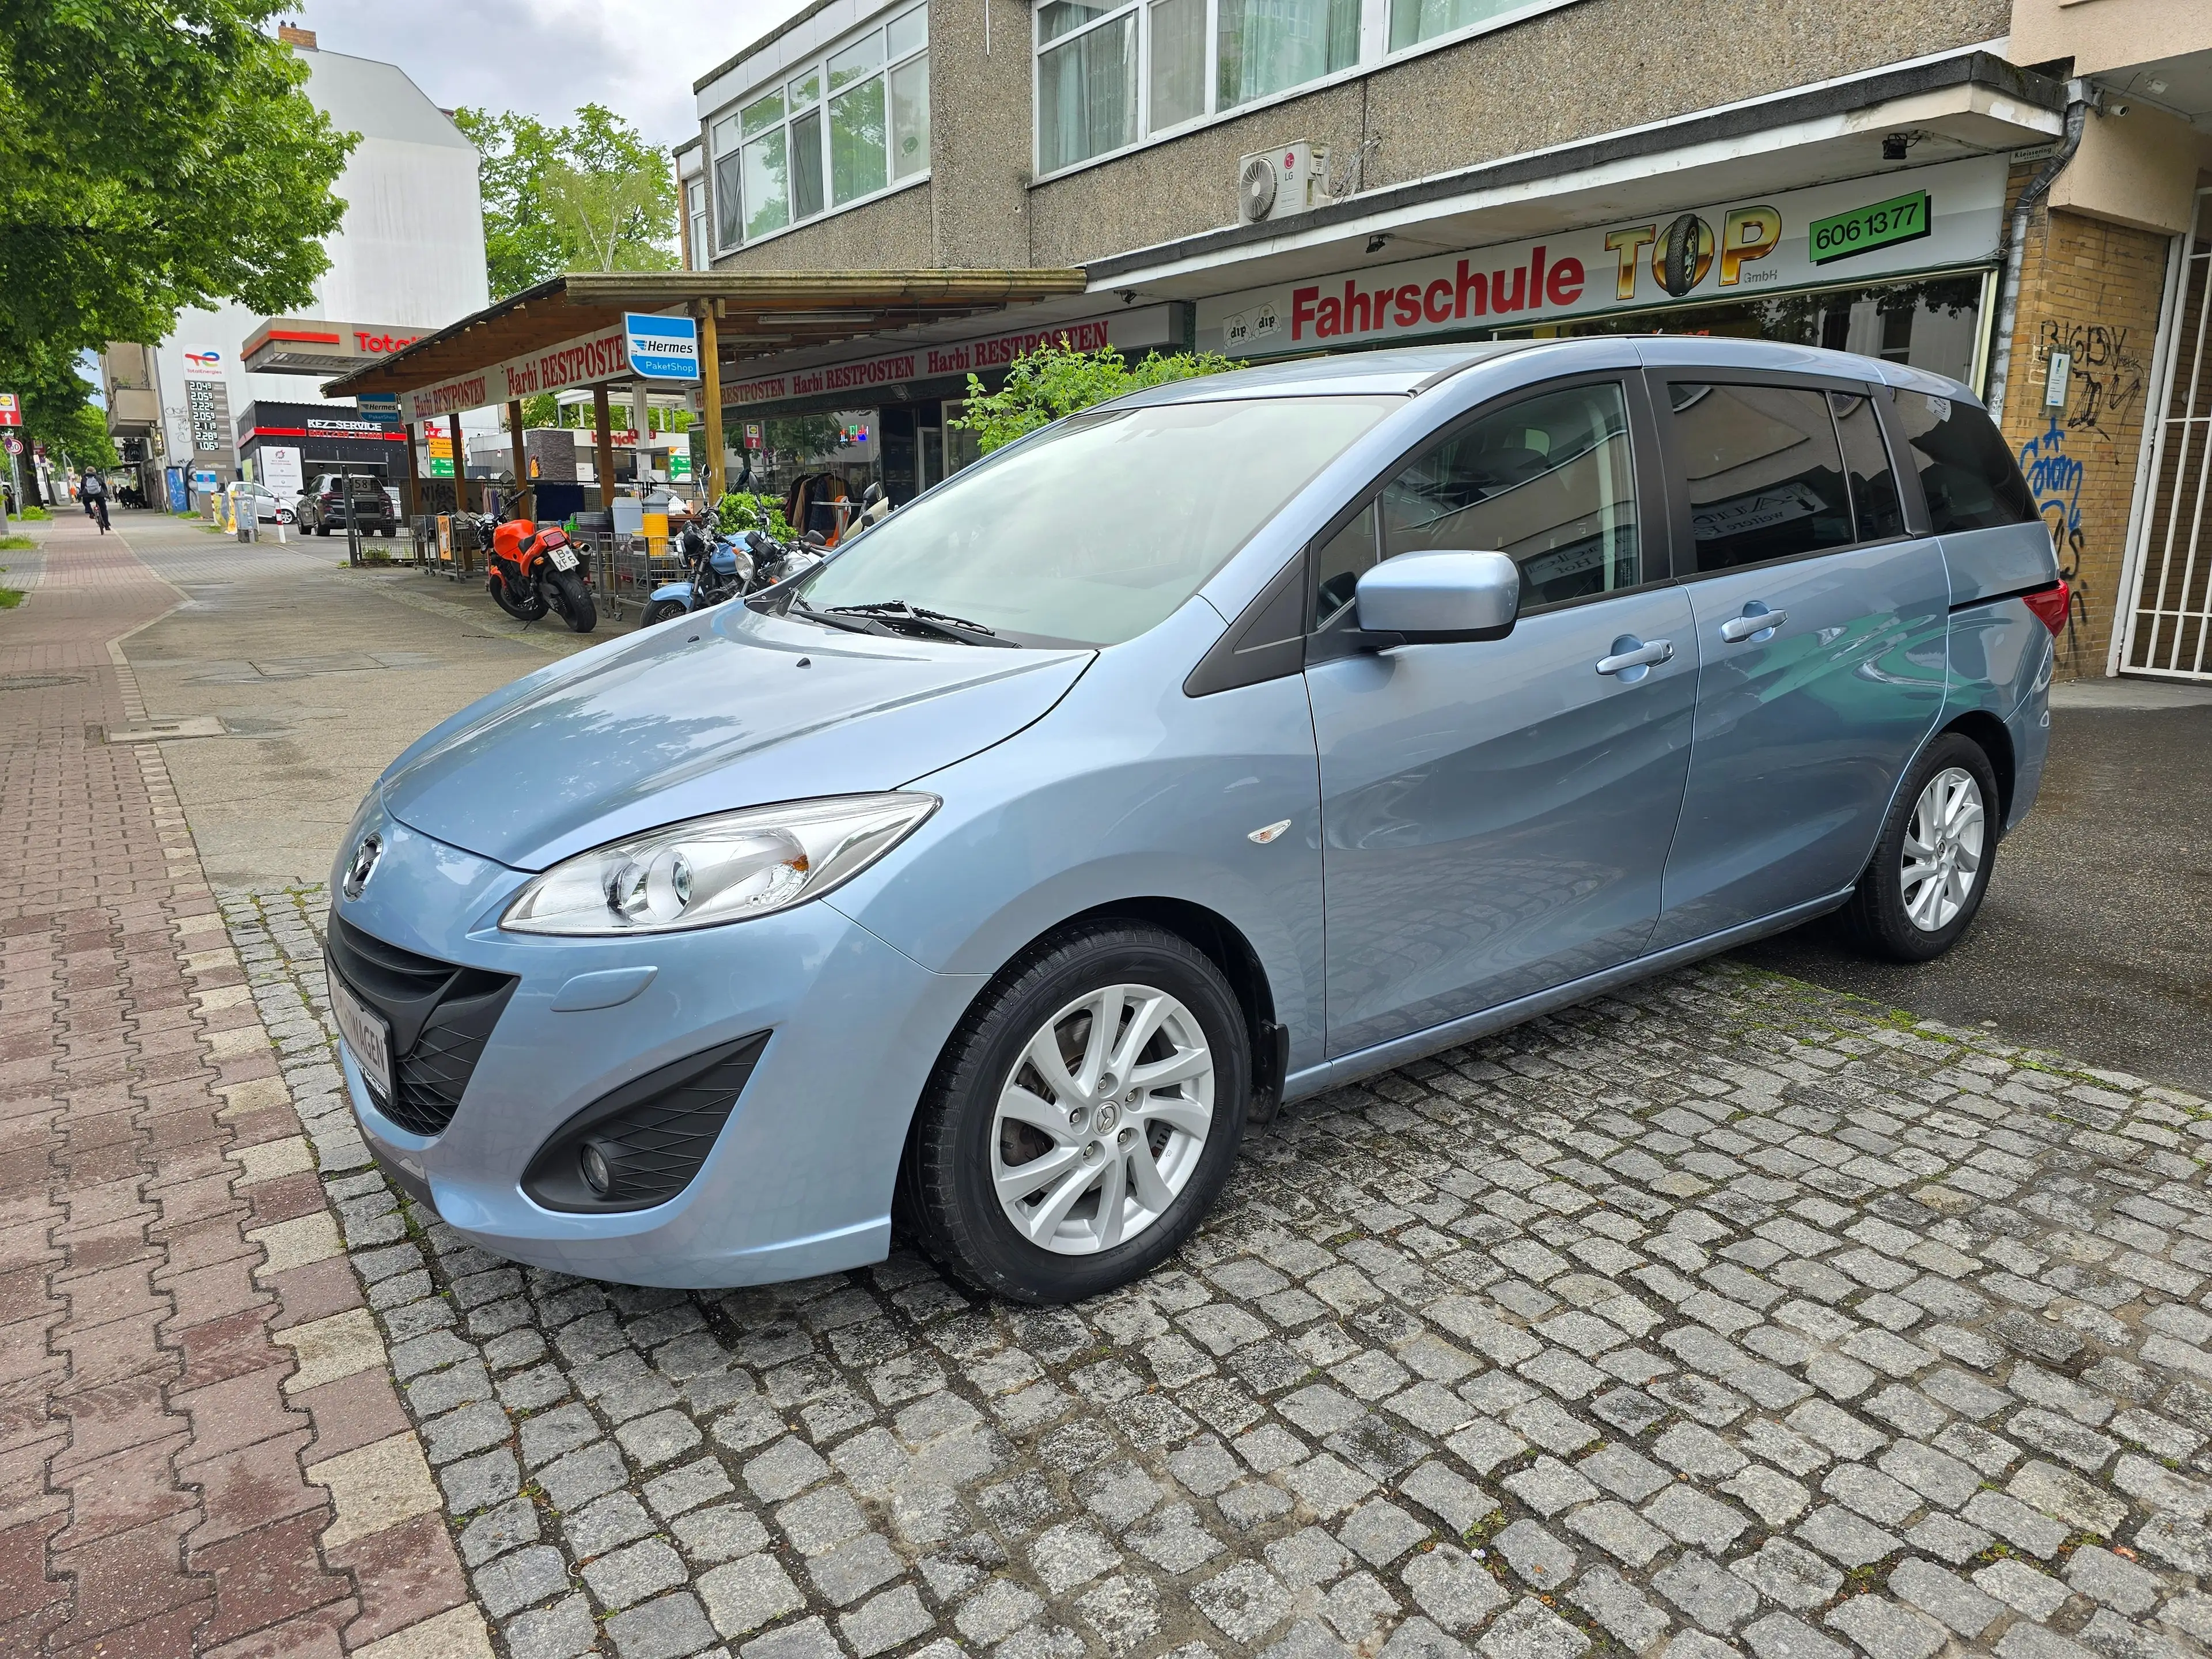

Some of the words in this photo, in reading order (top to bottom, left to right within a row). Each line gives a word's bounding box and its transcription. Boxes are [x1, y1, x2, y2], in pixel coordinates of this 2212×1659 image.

[1285, 171, 1293, 181] LG
[1605, 204, 1782, 300] TOP
[1743, 268, 1778, 285] GmbH
[1291, 245, 1585, 341] Fahrschule
[1259, 316, 1275, 328] dip
[1230, 325, 1246, 338] dip
[647, 340, 694, 354] Hermes
[927, 345, 971, 374] Harbi
[974, 320, 1109, 366] RESTPOSTEN
[506, 359, 539, 397] Harbi
[540, 334, 627, 390] RESTPOSTE
[646, 361, 694, 373] PaketShop
[793, 370, 824, 396] Harbi
[825, 355, 915, 390] RESTPOSTEN
[414, 392, 433, 418] Harbi
[433, 376, 486, 414] RESTPOSTEN
[336, 421, 382, 431] SERVICE
[354, 479, 368, 488] 58
[556, 549, 565, 559] B
[556, 558, 567, 570] XF
[567, 555, 576, 564] 5
